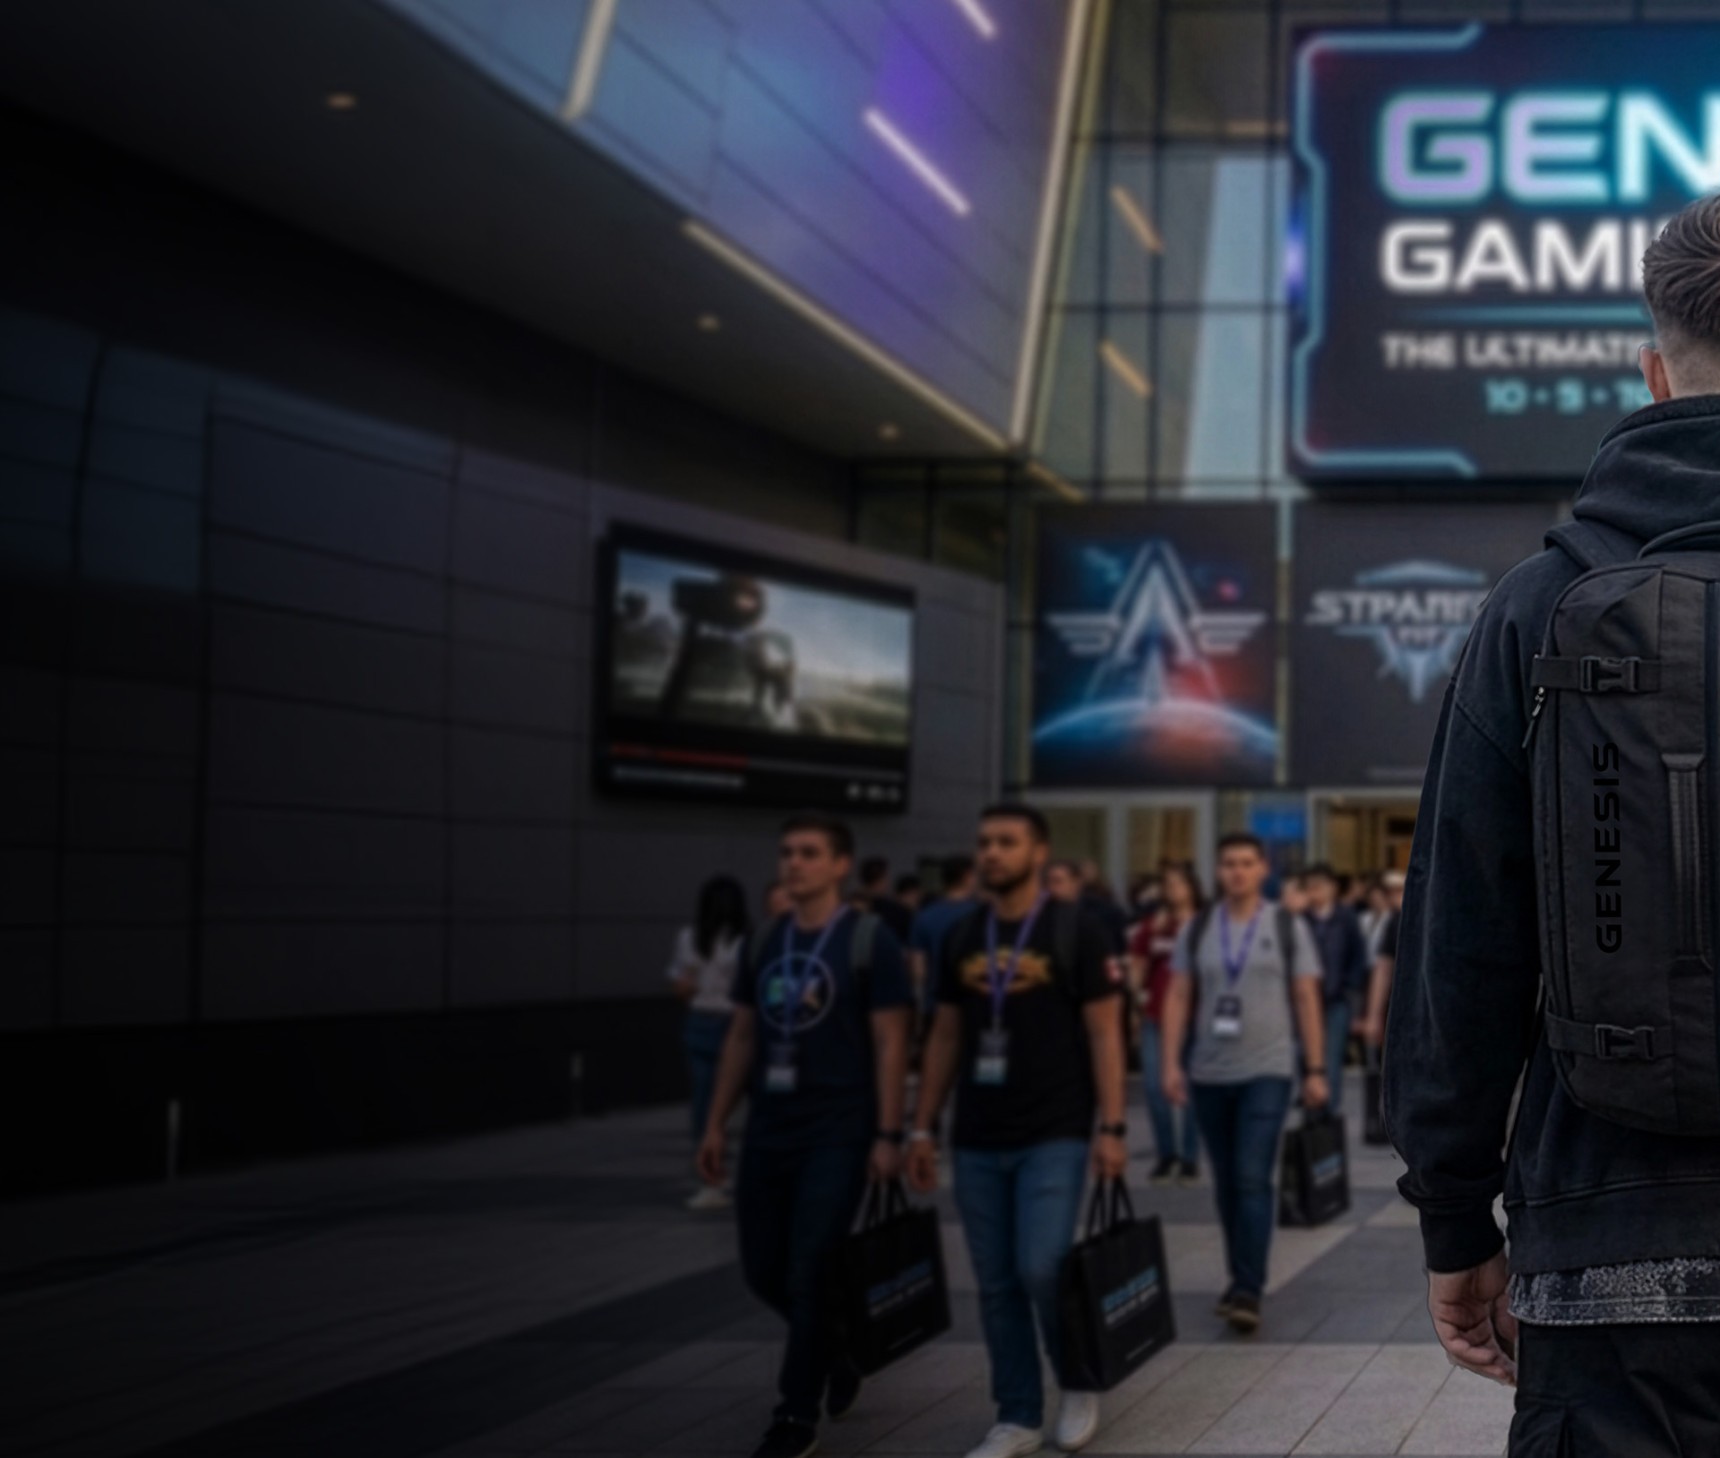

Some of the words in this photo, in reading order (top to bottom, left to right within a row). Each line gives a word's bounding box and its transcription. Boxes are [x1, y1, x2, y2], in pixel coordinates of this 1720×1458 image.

[1380, 217, 1666, 292] GAMI
[1382, 332, 1456, 370] THE
[1593, 742, 1622, 954] GENESIS
